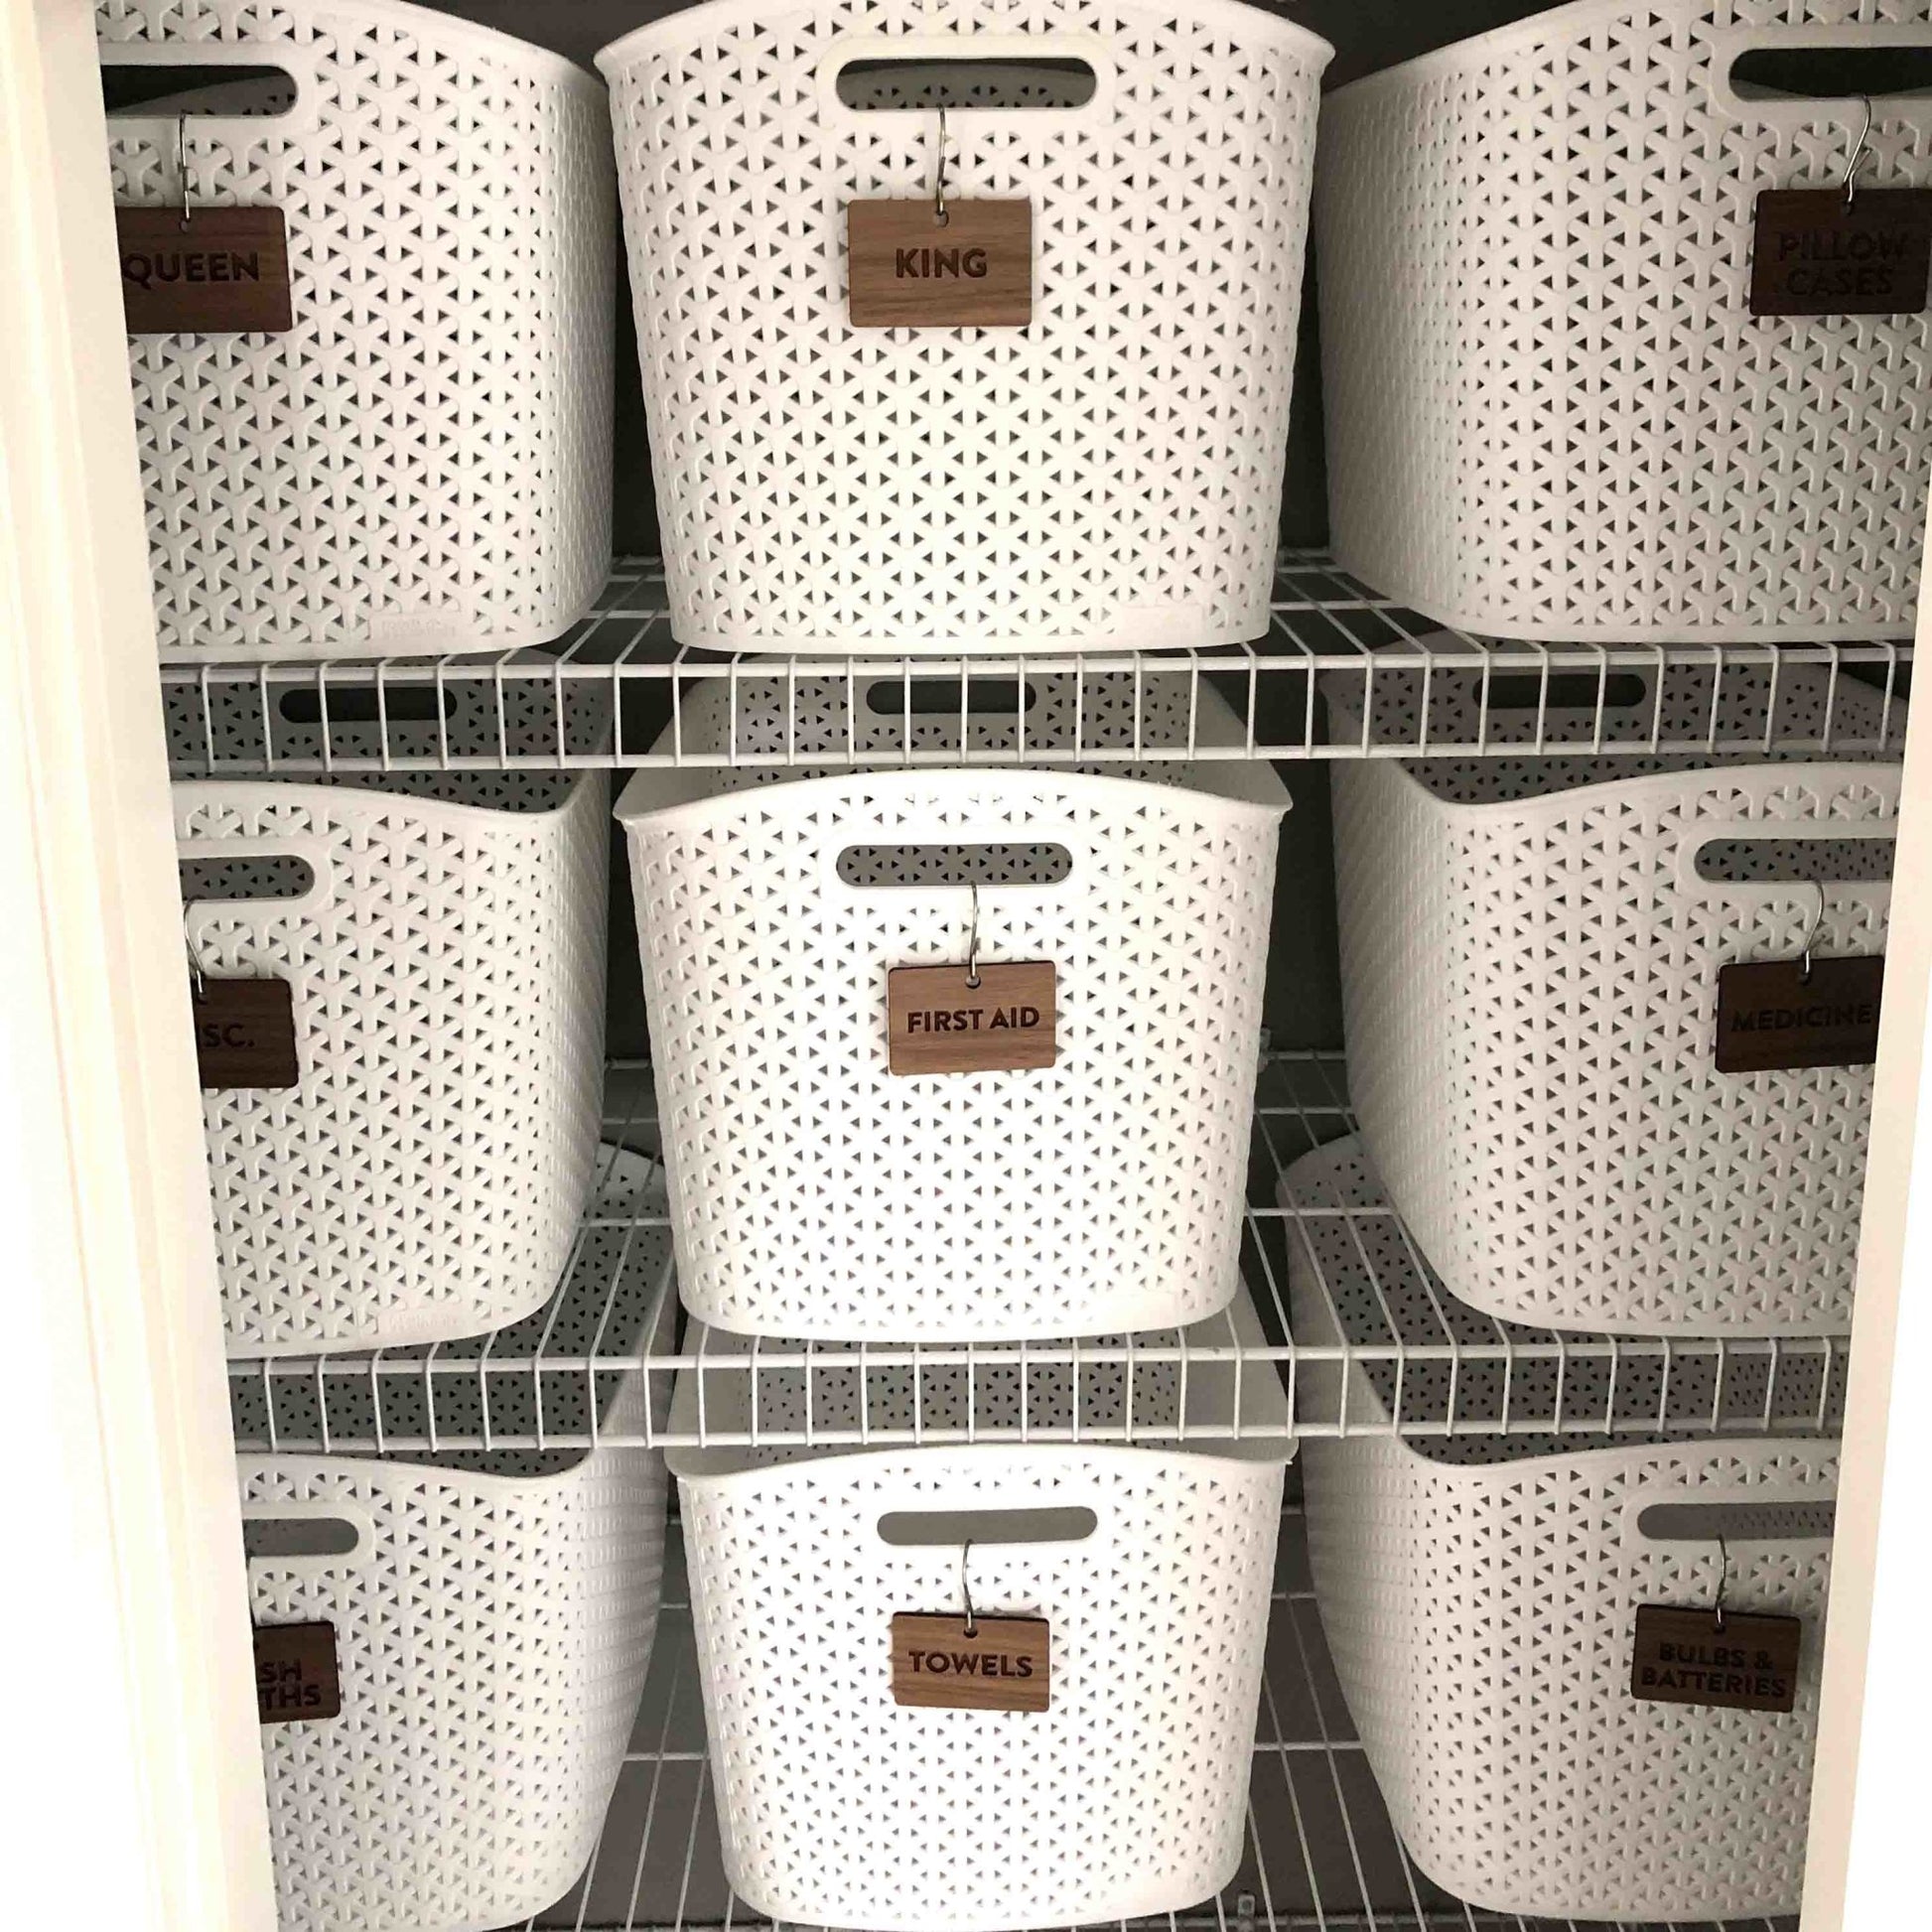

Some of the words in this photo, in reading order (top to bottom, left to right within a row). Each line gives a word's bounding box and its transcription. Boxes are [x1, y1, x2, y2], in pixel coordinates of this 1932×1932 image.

[1778, 229, 1909, 262] PILLOW
[122, 252, 260, 290] QUEEN
[896, 247, 988, 279] KING
[1786, 267, 1894, 296] CASES
[907, 1009, 984, 1034] FIRST
[990, 1006, 1040, 1030] AID
[1730, 1003, 1873, 1033] MEDICINE
[908, 1650, 1034, 1678] TOWELS
[1659, 1642, 1747, 1668] BULBS
[1753, 1650, 1774, 1670] &
[1641, 1668, 1787, 1698] BATTERIES
